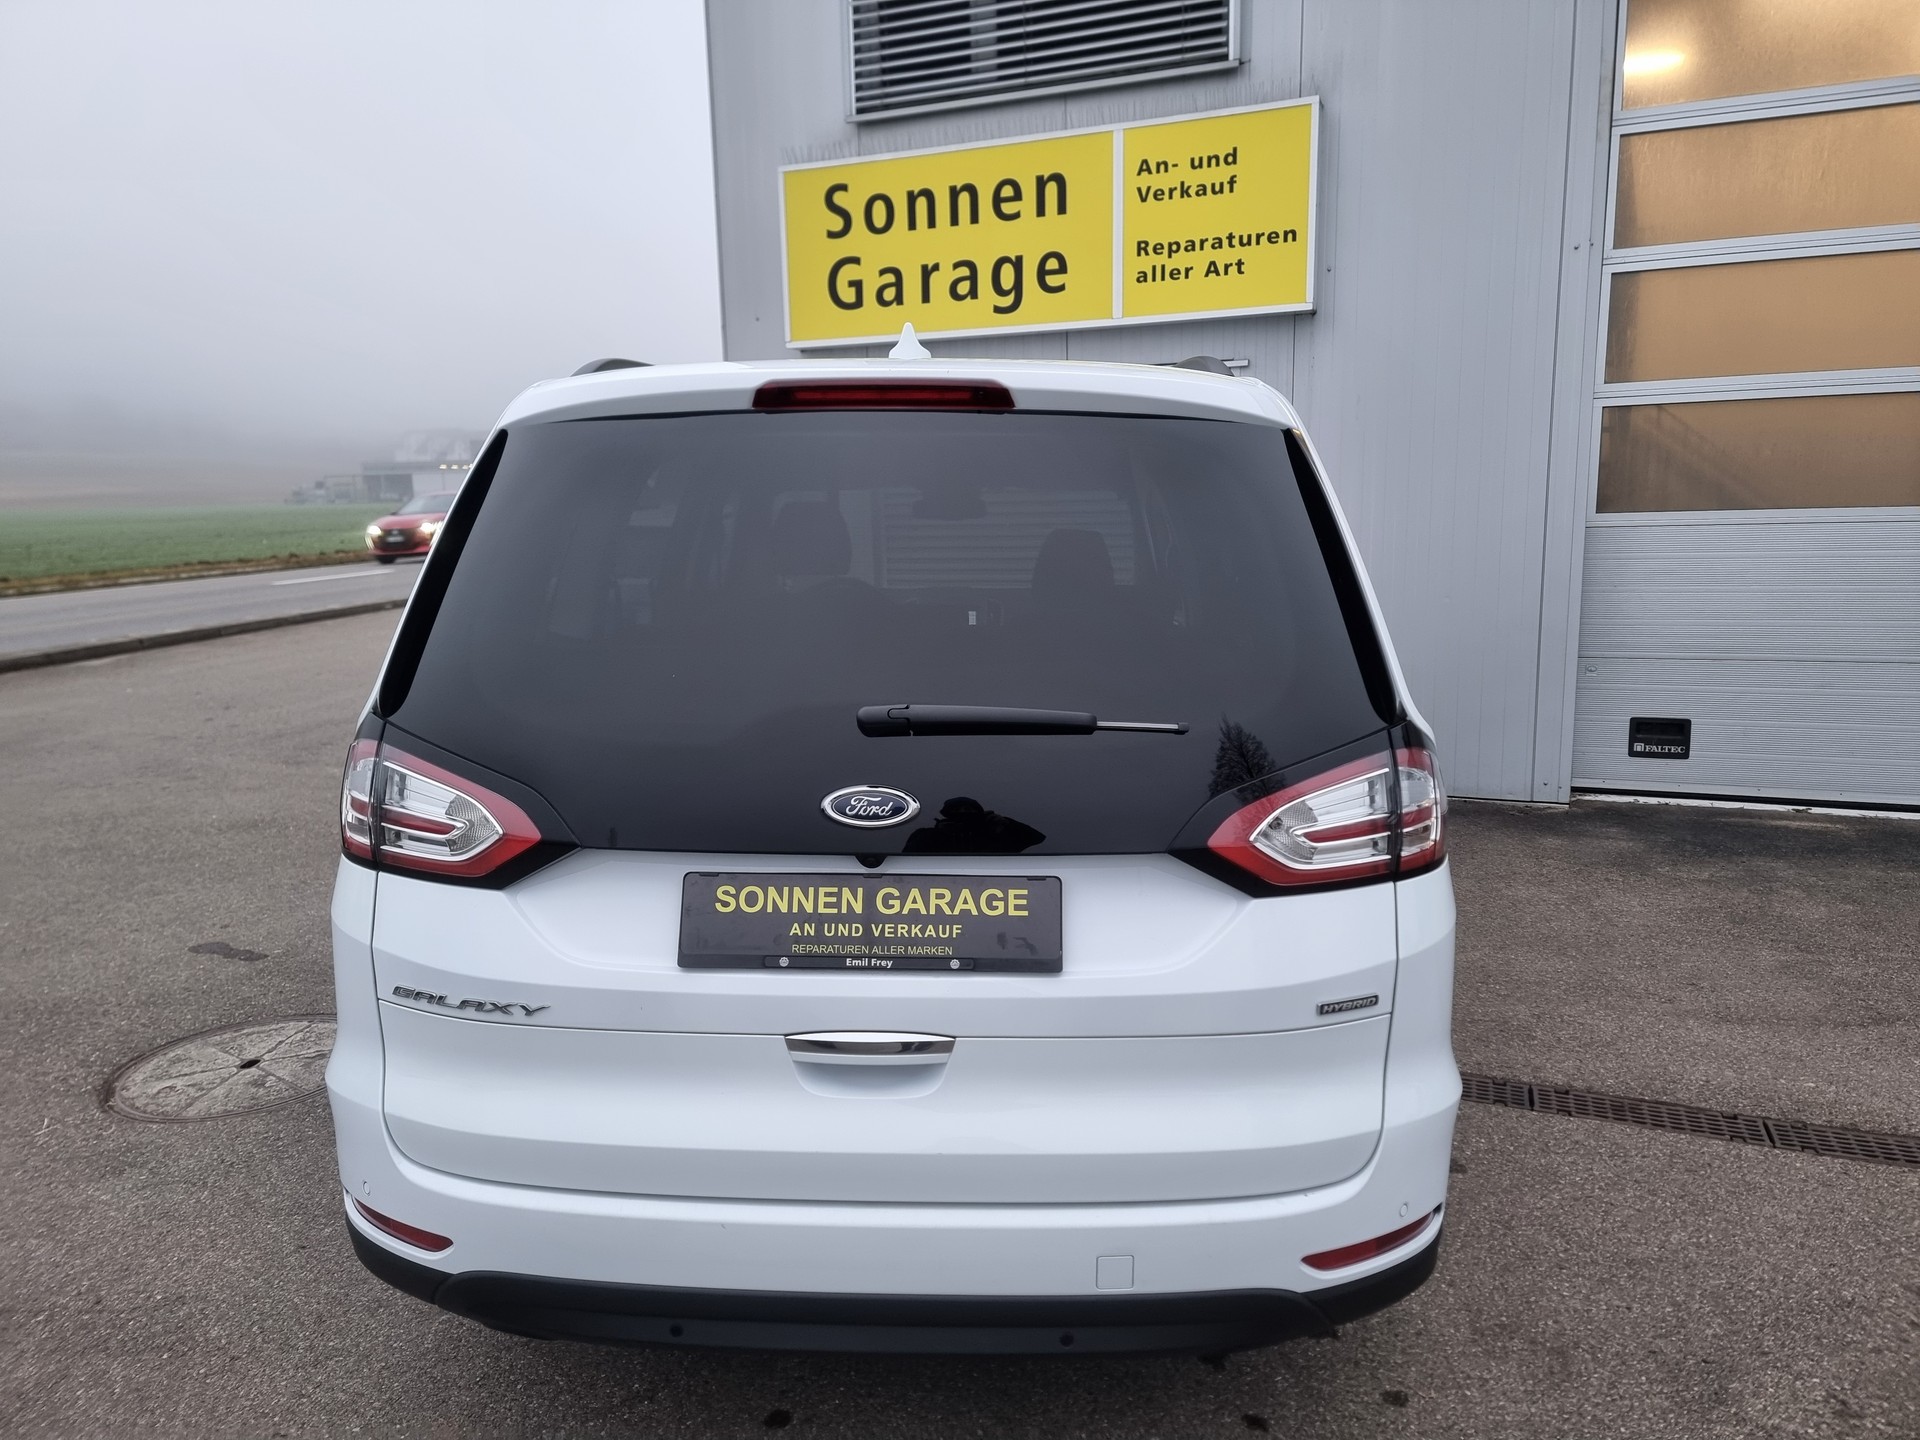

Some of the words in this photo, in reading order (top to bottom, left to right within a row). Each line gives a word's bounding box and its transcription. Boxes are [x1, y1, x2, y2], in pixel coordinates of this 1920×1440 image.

[1136, 158, 1179, 177] An-
[1189, 146, 1238, 171] und
[1136, 174, 1238, 203] Verkauf
[823, 171, 1068, 240] Sonnen
[1136, 228, 1298, 259] Reparaturen
[826, 249, 1069, 315] Garage
[1135, 263, 1194, 284] aller
[1203, 258, 1246, 278] Art
[1645, 745, 1686, 753] FALTEC
[845, 795, 894, 817] Ford
[714, 885, 864, 914] SONNEN
[875, 887, 1029, 916] GARAGE
[789, 922, 816, 937] AN
[824, 922, 864, 938] UND
[871, 923, 963, 939] VERKAUF
[791, 943, 870, 955] REPARATUREN
[871, 944, 906, 956] ALLER
[907, 945, 954, 957] MARKEN
[845, 958, 869, 968] Emil
[871, 958, 893, 969] Frey
[392, 984, 551, 1016] GALAXY
[1322, 997, 1377, 1013] HYBRID
